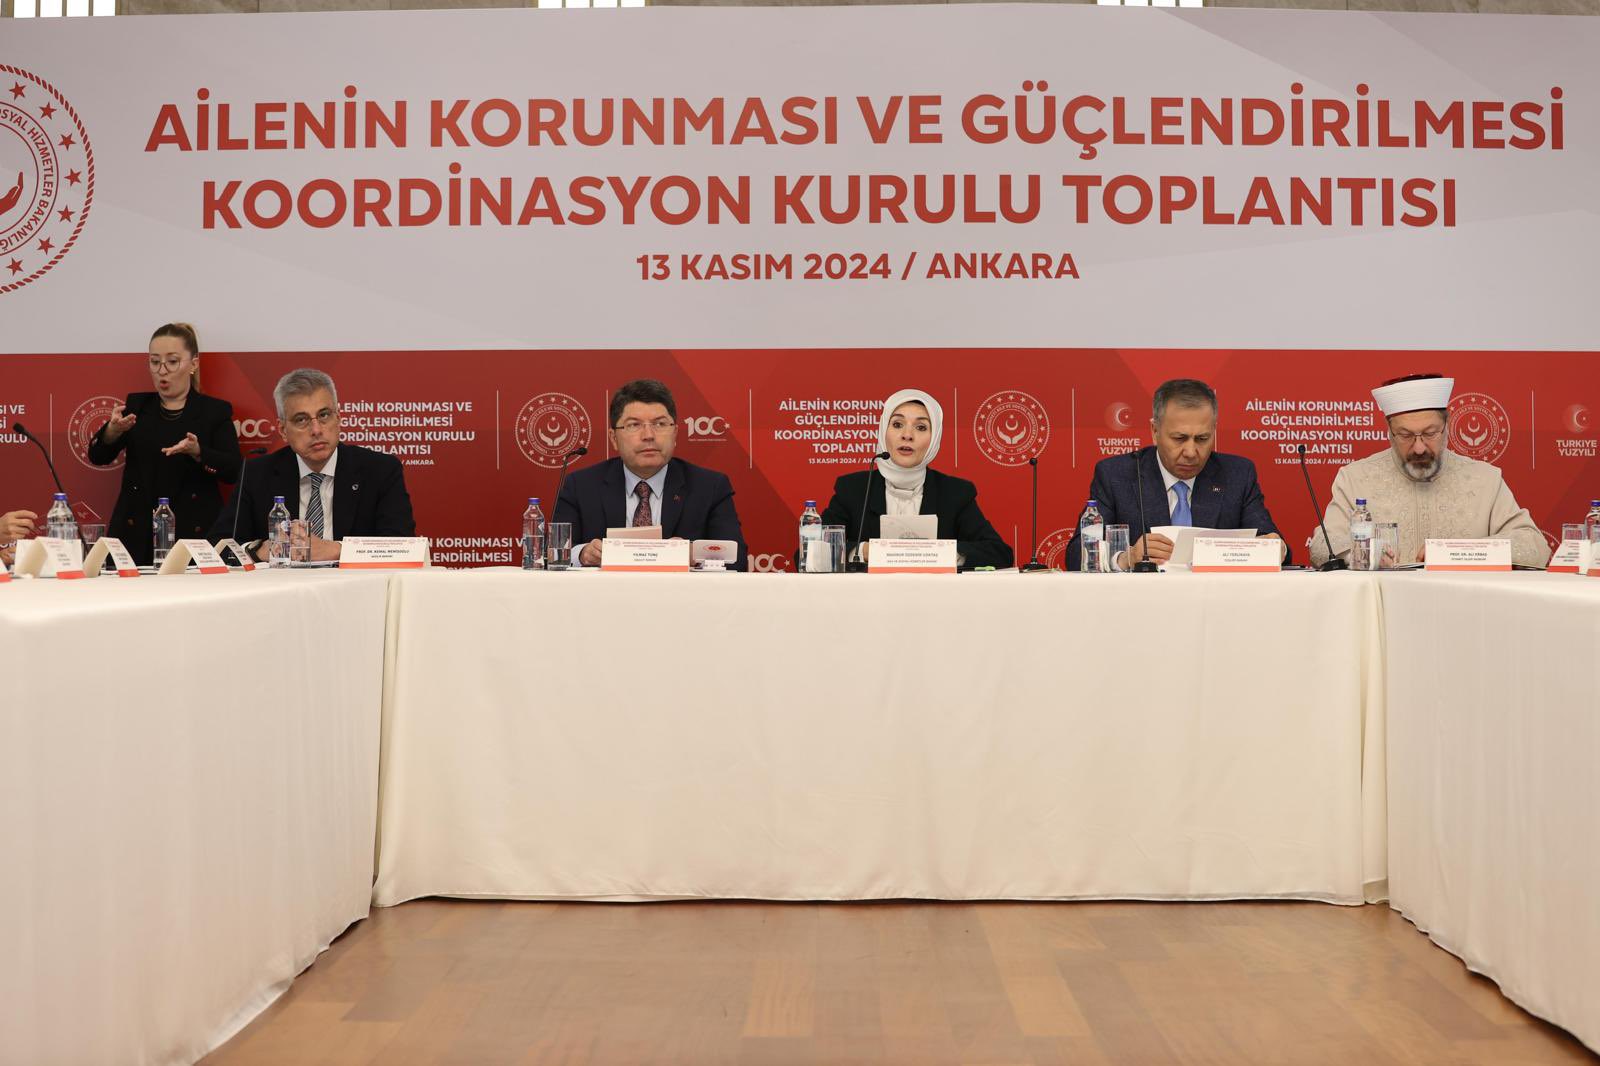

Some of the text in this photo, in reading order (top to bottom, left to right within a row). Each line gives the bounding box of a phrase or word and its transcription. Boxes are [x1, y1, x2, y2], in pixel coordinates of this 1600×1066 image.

[0, 108, 27, 131] SYAL
[145, 80, 1564, 161] AİLENİN KORUNMASI VE GÜÇLENDİRİLMESİ
[203, 161, 1456, 230] KOORDİNASYON KURULU TOPLANTISI
[0, 199, 49, 252] BAKANLIĞ
[637, 251, 1080, 281] 13 KASIM 2024 / ANKARA
[10, 404, 25, 414] VE
[338, 400, 472, 413] LENİN KORUNMASI VE
[779, 398, 885, 411] AİLENİN KORUN
[1246, 398, 1295, 411] AİLENİN
[1299, 401, 1374, 411] KORUNMASI
[340, 414, 453, 429] GÜÇLENDİRİLMESİ
[795, 412, 880, 428] GÜÇLENDİRİL
[1261, 413, 1374, 428] GÜÇLENDİRİLMESİ
[339, 428, 475, 442] ORDİNASYON KURULU
[774, 427, 878, 440] KOORDİNASYON
[1241, 427, 1343, 440] KOORDİNASYON
[359, 445, 431, 455] PLANTISI
[812, 442, 876, 453] TOPLANTI
[436, 537, 513, 548] KORUNMASI
[430, 550, 513, 563] ENDİRİLMESİ
